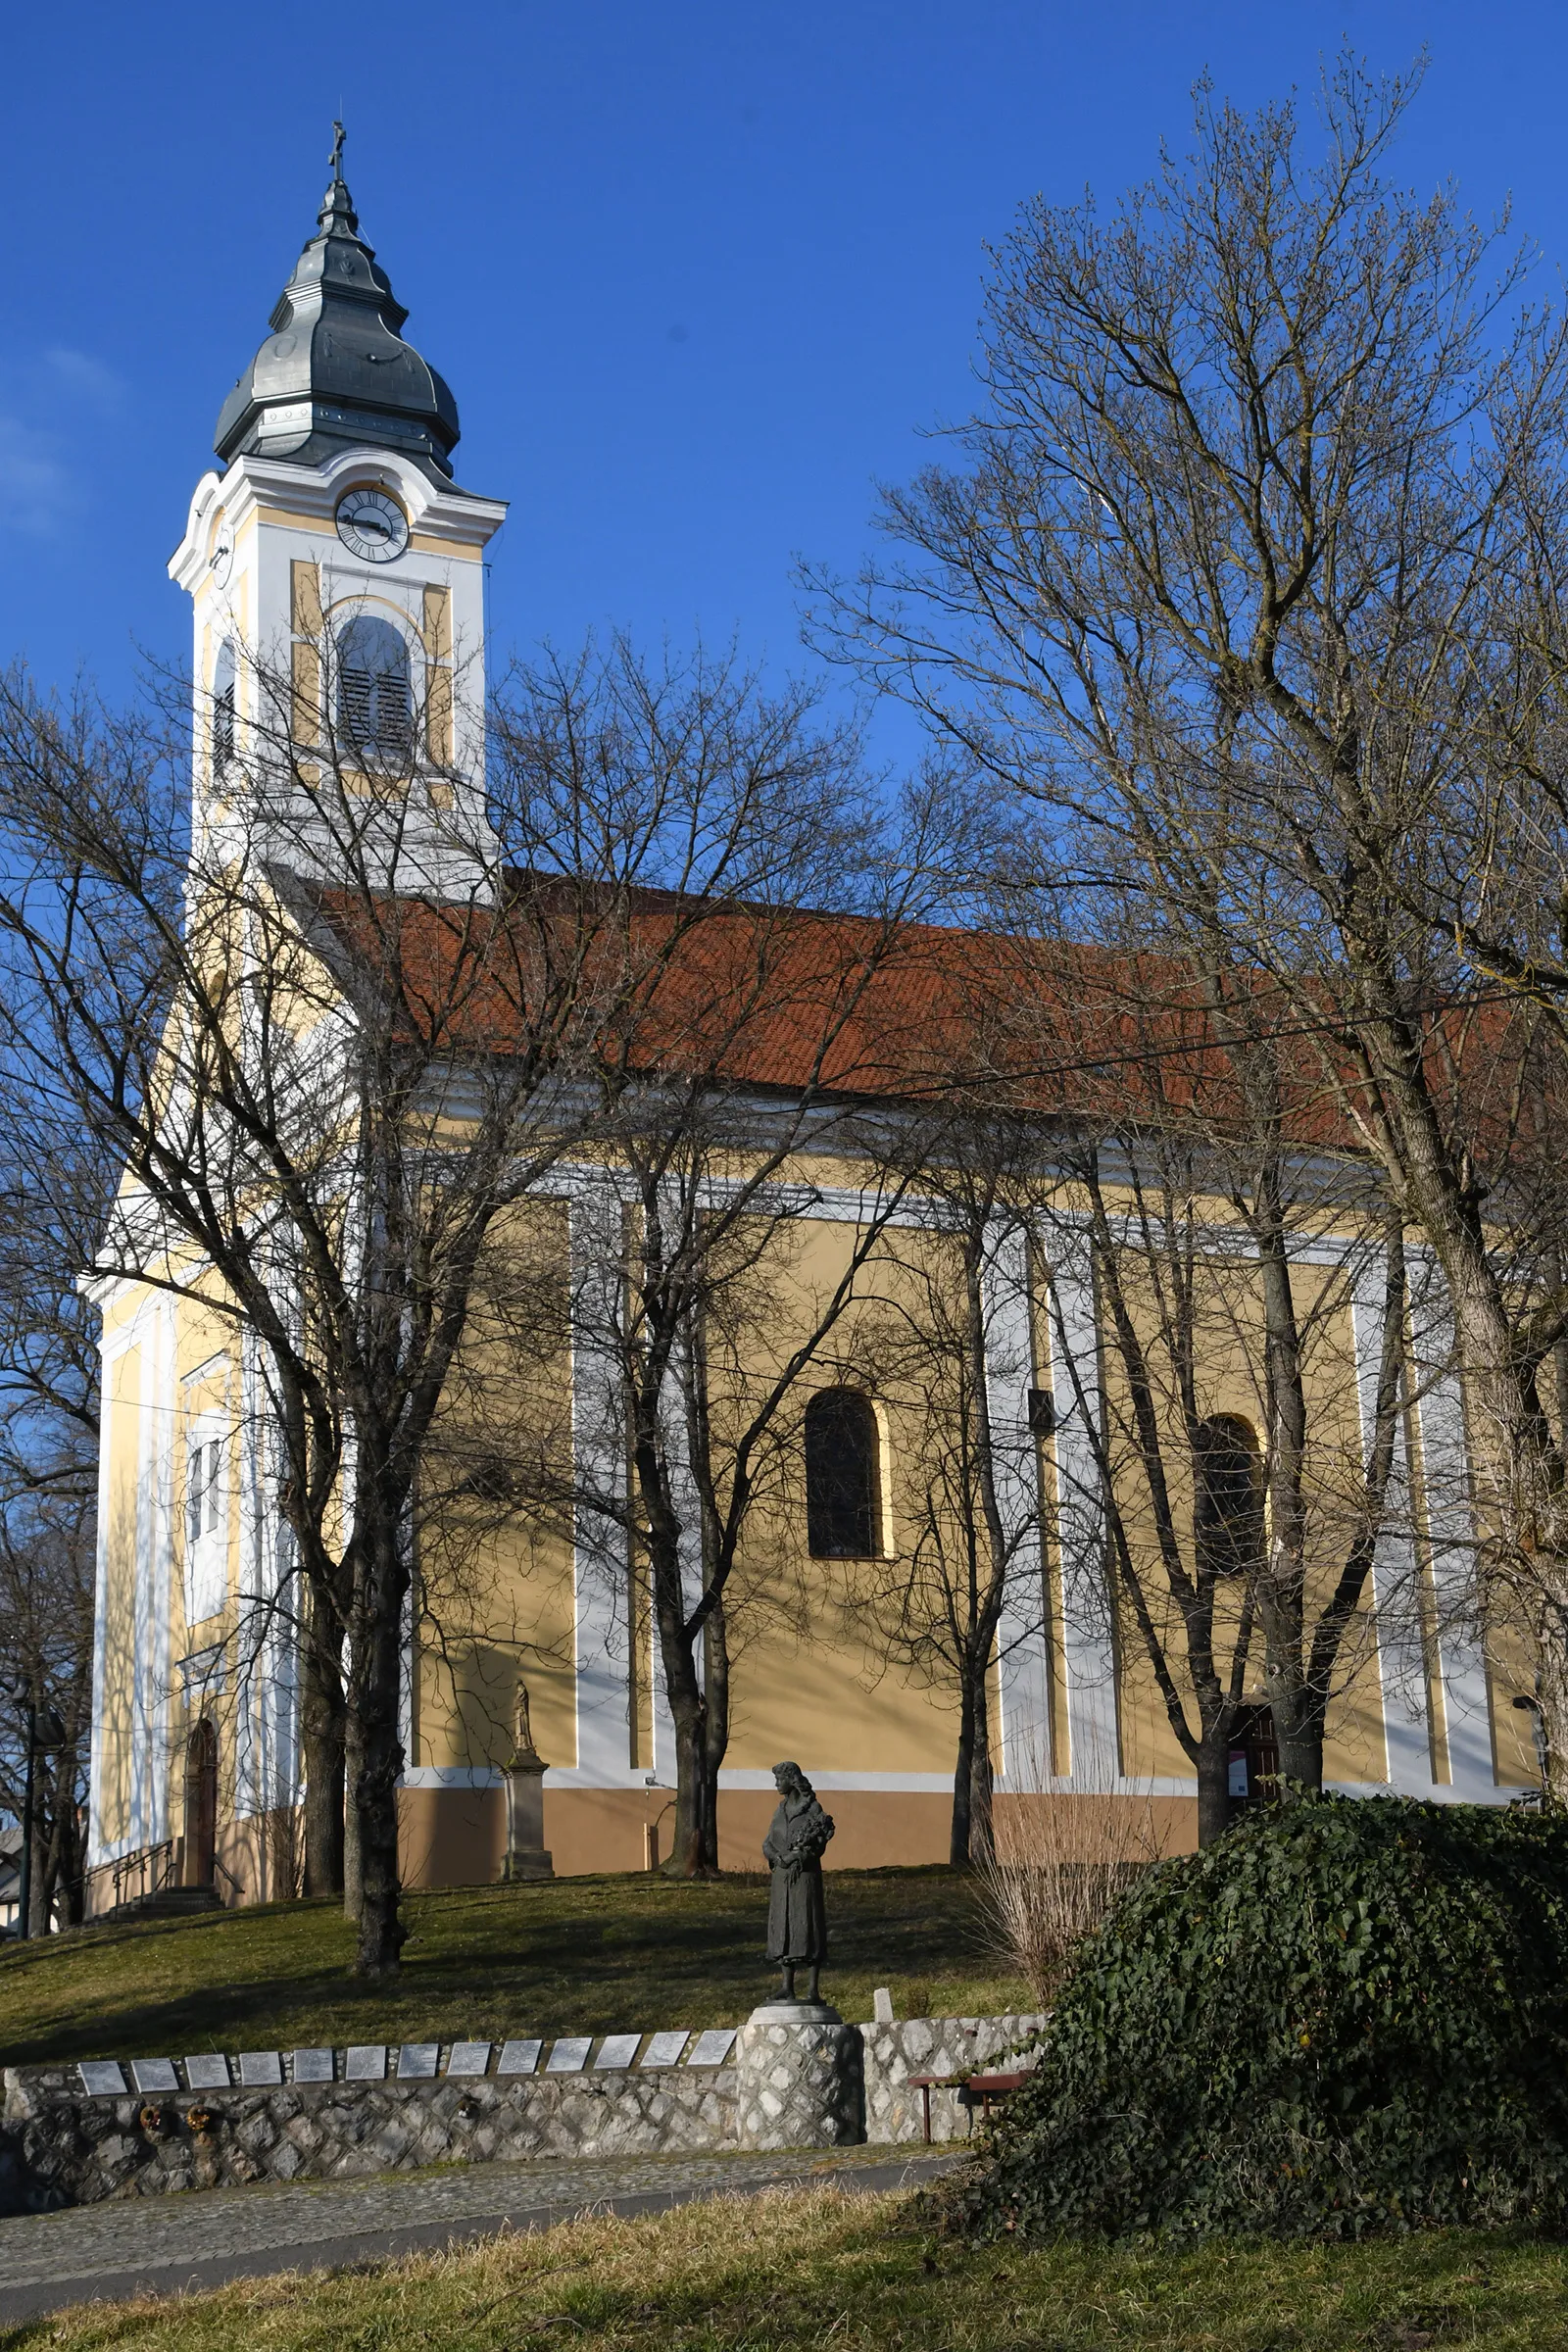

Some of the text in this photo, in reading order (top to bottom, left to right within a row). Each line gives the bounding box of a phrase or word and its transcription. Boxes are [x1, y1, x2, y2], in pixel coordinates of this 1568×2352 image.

[368, 492, 378, 507] XII
[390, 513, 403, 521] II
[394, 526, 407, 536] III
